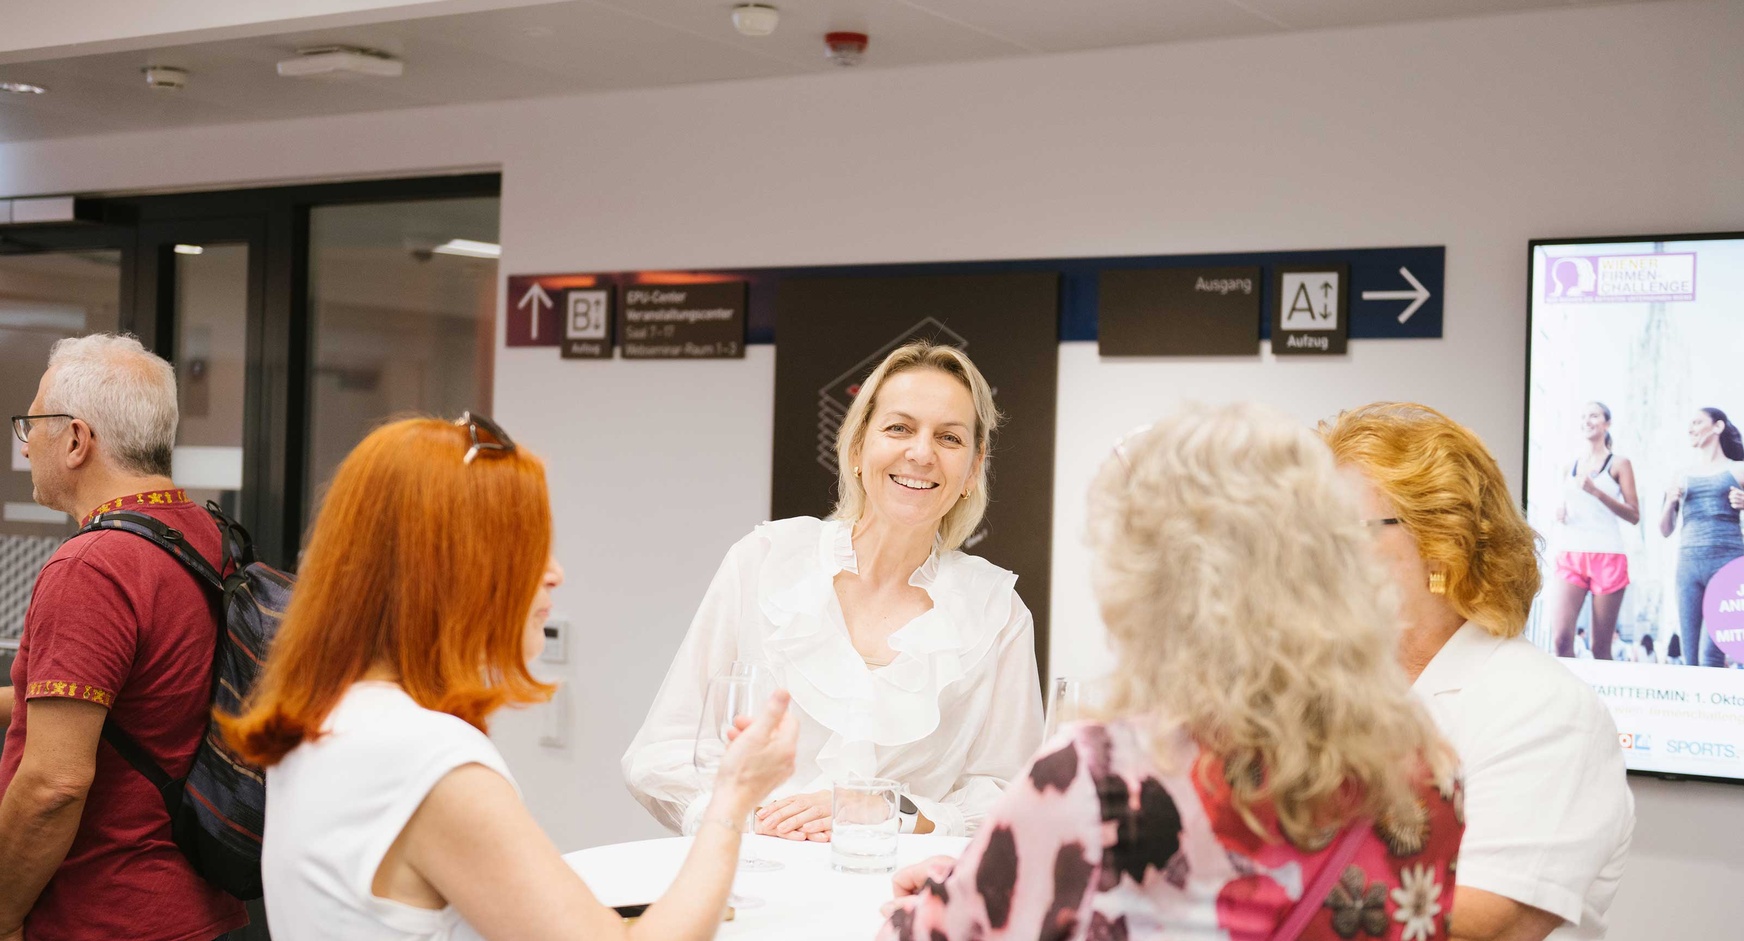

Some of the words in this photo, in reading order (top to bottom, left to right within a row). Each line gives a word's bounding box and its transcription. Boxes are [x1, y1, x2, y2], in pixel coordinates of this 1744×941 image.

[1602, 258, 1658, 270] WIENER
[1195, 276, 1252, 295] Ausgang
[1601, 280, 1689, 293] CHALLENGE
[1287, 282, 1316, 321] A
[572, 298, 591, 331] B
[1286, 334, 1329, 350] Aufzug
[1715, 629, 1744, 643] MIT
[1695, 692, 1706, 704] 1.
